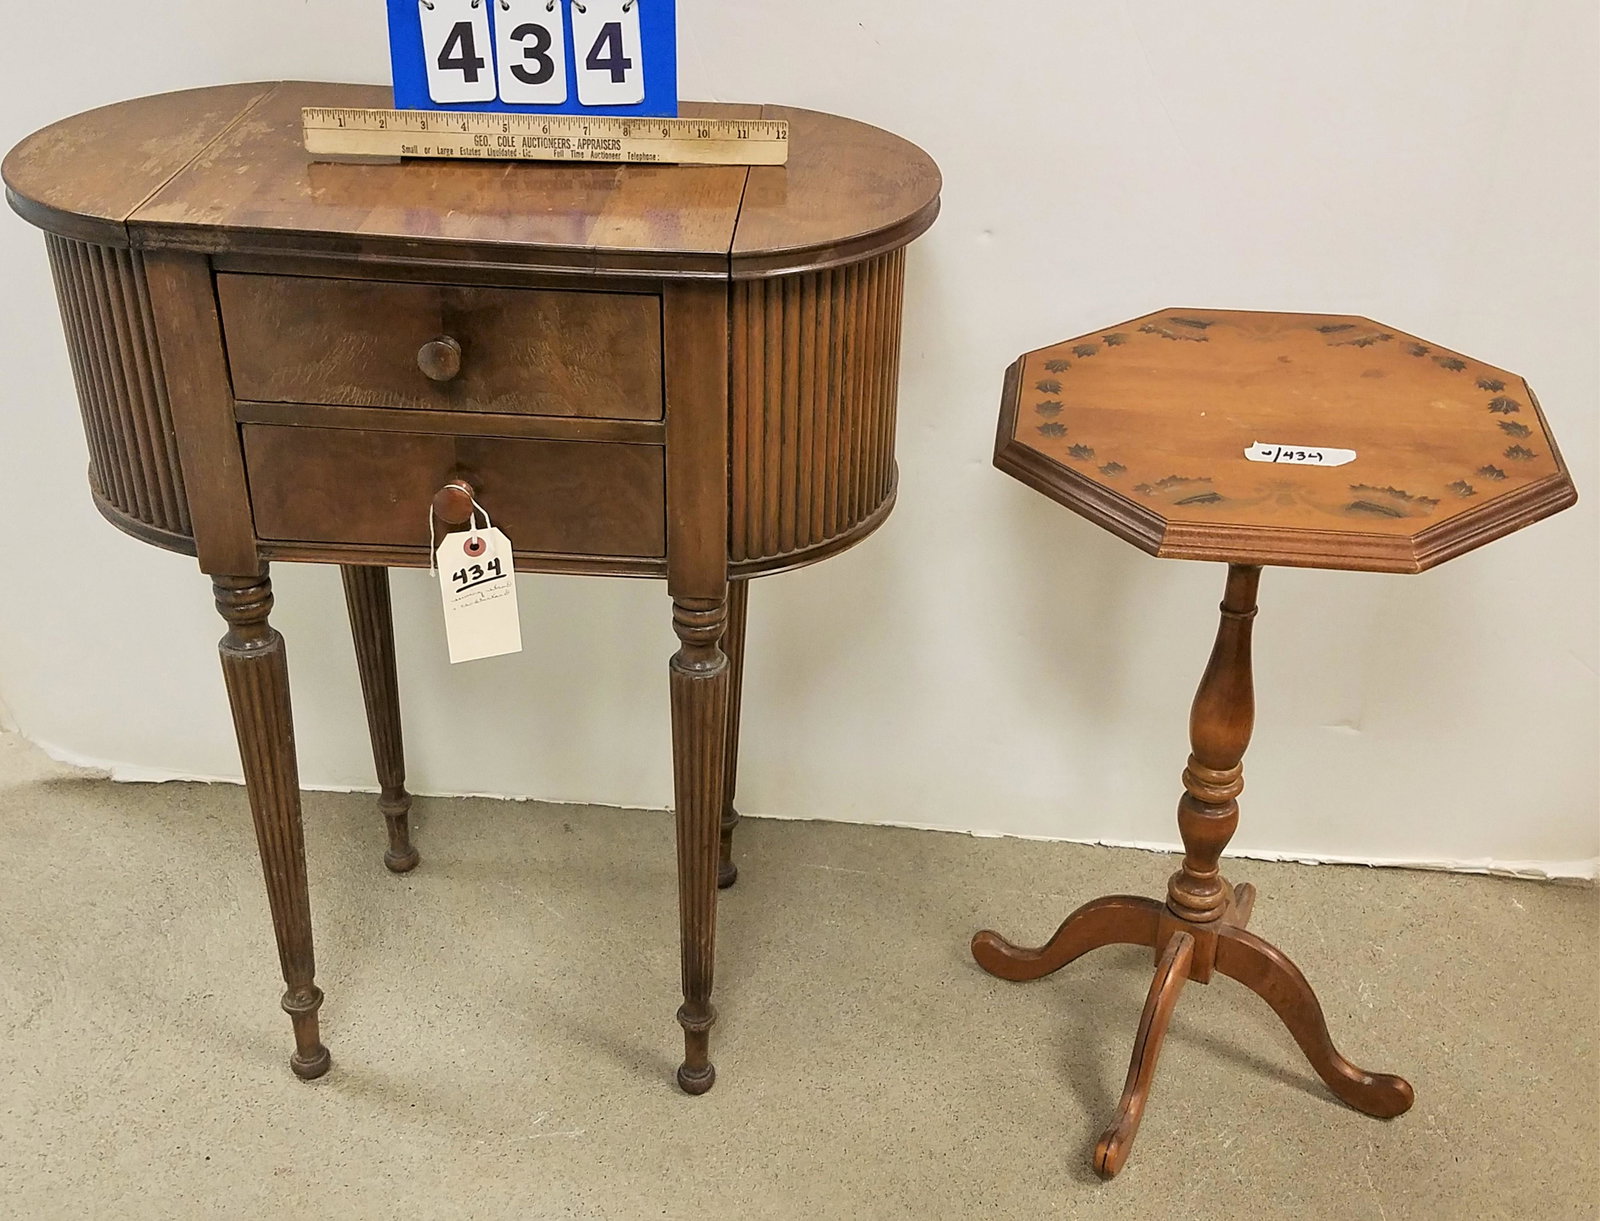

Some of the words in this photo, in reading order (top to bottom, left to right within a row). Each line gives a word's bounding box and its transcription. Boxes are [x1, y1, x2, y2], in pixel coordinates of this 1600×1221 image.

[338, 117, 344, 128] 1
[379, 119, 385, 129] 2
[420, 120, 426, 130] 3
[460, 122, 467, 132] 4
[502, 123, 508, 133] 5
[542, 124, 548, 134] 6
[582, 126, 588, 136] 7
[622, 127, 628, 137] 8
[662, 128, 668, 138] 9
[697, 129, 708, 139] 10
[737, 129, 747, 139] 11
[775, 130, 787, 140] 12
[473, 134, 491, 148] GEO.
[497, 135, 516, 148] COLE
[401, 144, 418, 155] Small
[424, 146, 431, 155] or
[437, 146, 454, 157] Large
[459, 146, 481, 157] Estates
[570, 149, 585, 159] Time
[590, 150, 621, 160] Auctioneer
[452, 557, 502, 584] 434
